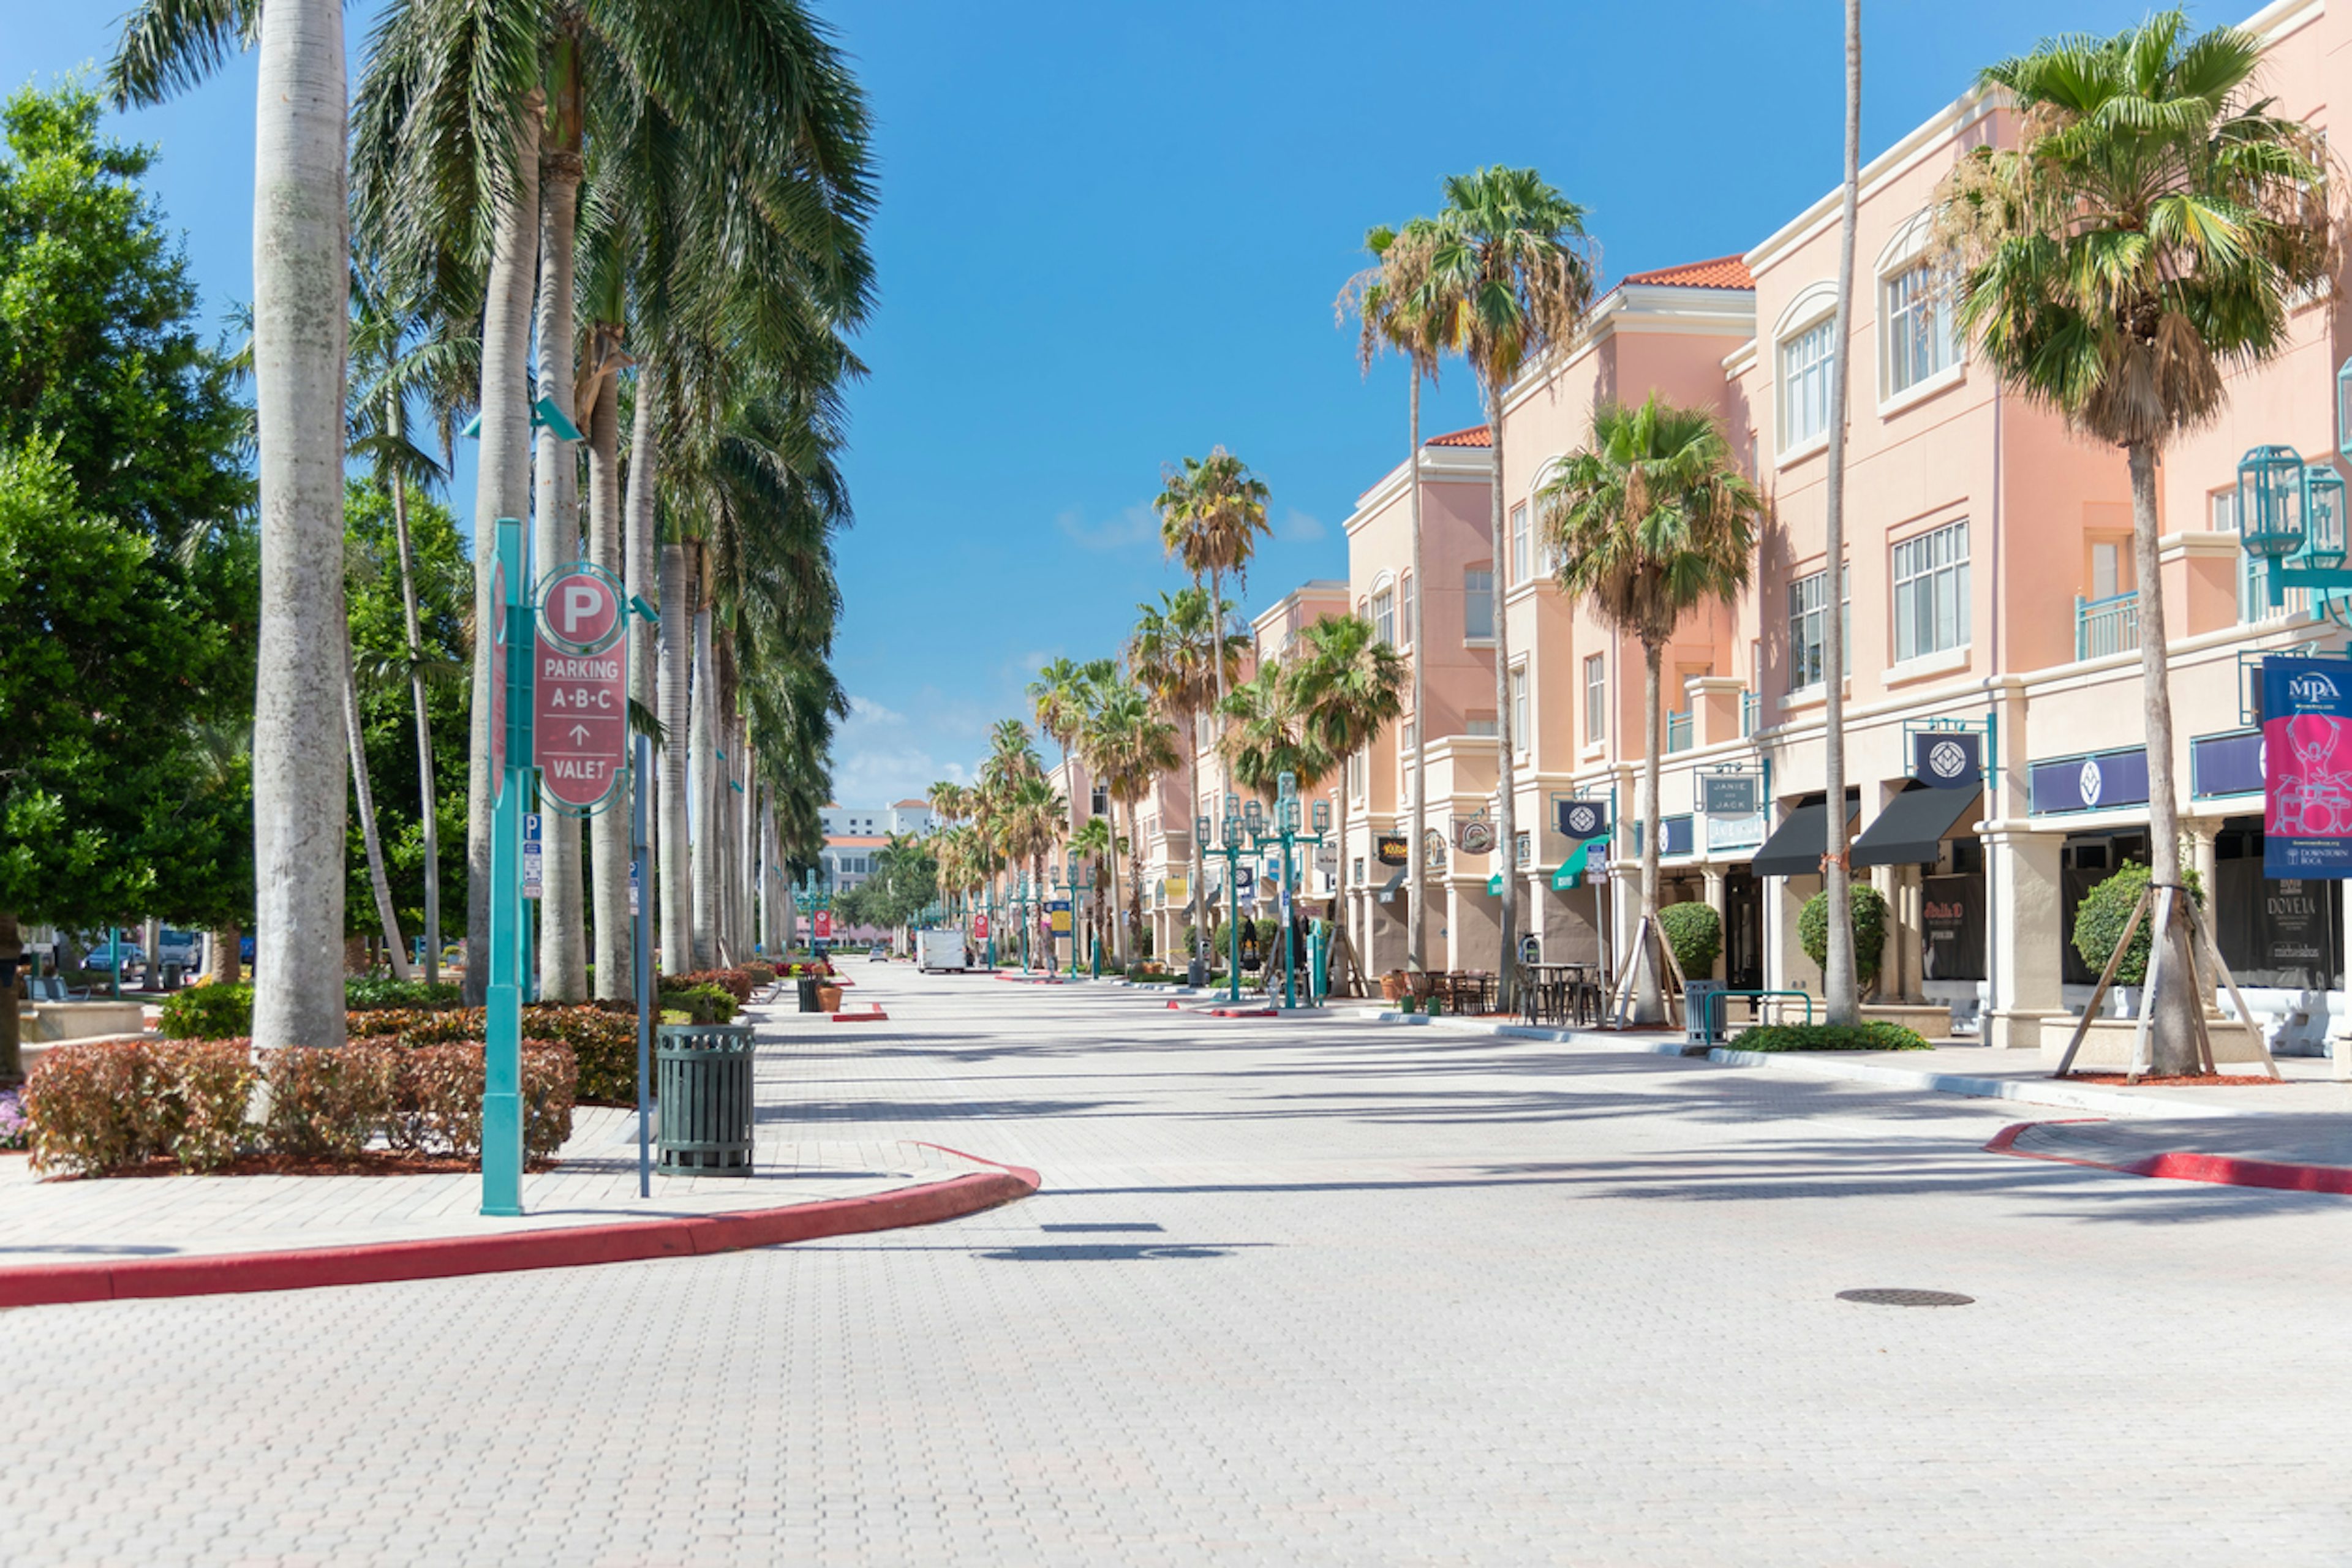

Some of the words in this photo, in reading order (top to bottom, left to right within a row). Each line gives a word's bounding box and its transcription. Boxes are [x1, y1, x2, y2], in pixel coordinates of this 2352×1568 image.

[564, 586, 603, 633] P
[545, 658, 618, 679] PARKING
[553, 760, 606, 778] VALET
[526, 815, 538, 839] P
